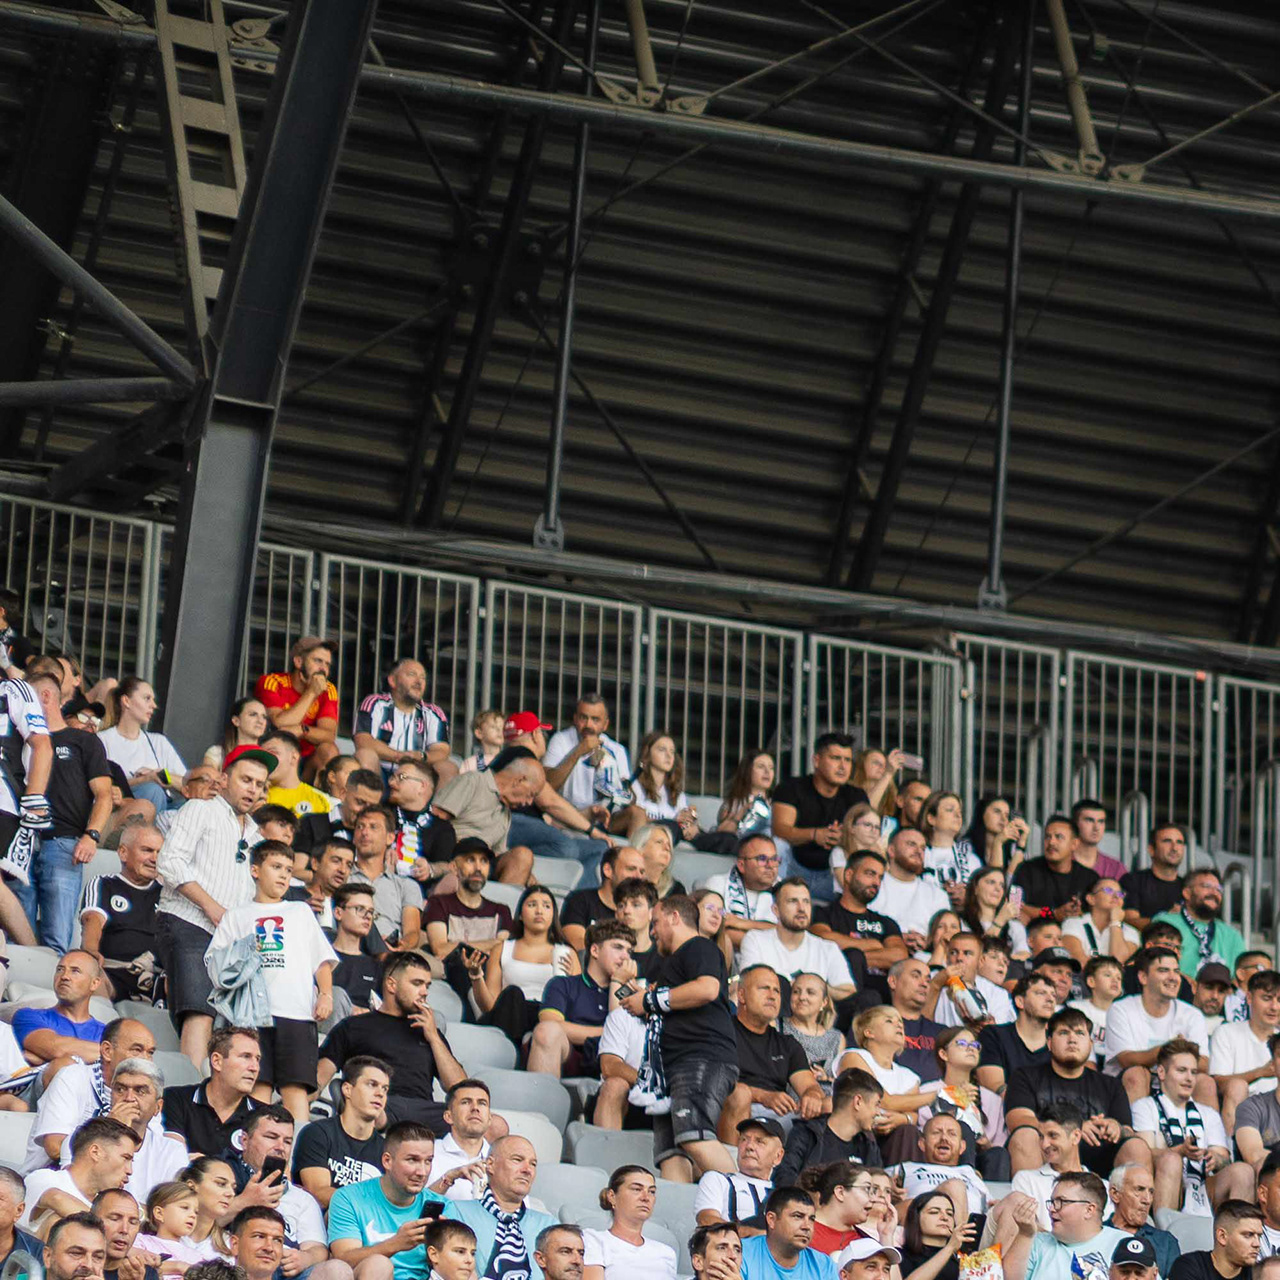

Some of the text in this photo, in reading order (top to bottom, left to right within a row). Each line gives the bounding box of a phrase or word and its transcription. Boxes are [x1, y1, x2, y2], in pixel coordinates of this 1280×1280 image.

[327, 1157, 361, 1182] NORTH
[343, 1155, 363, 1170] THE
[966, 1264, 993, 1277] Star
